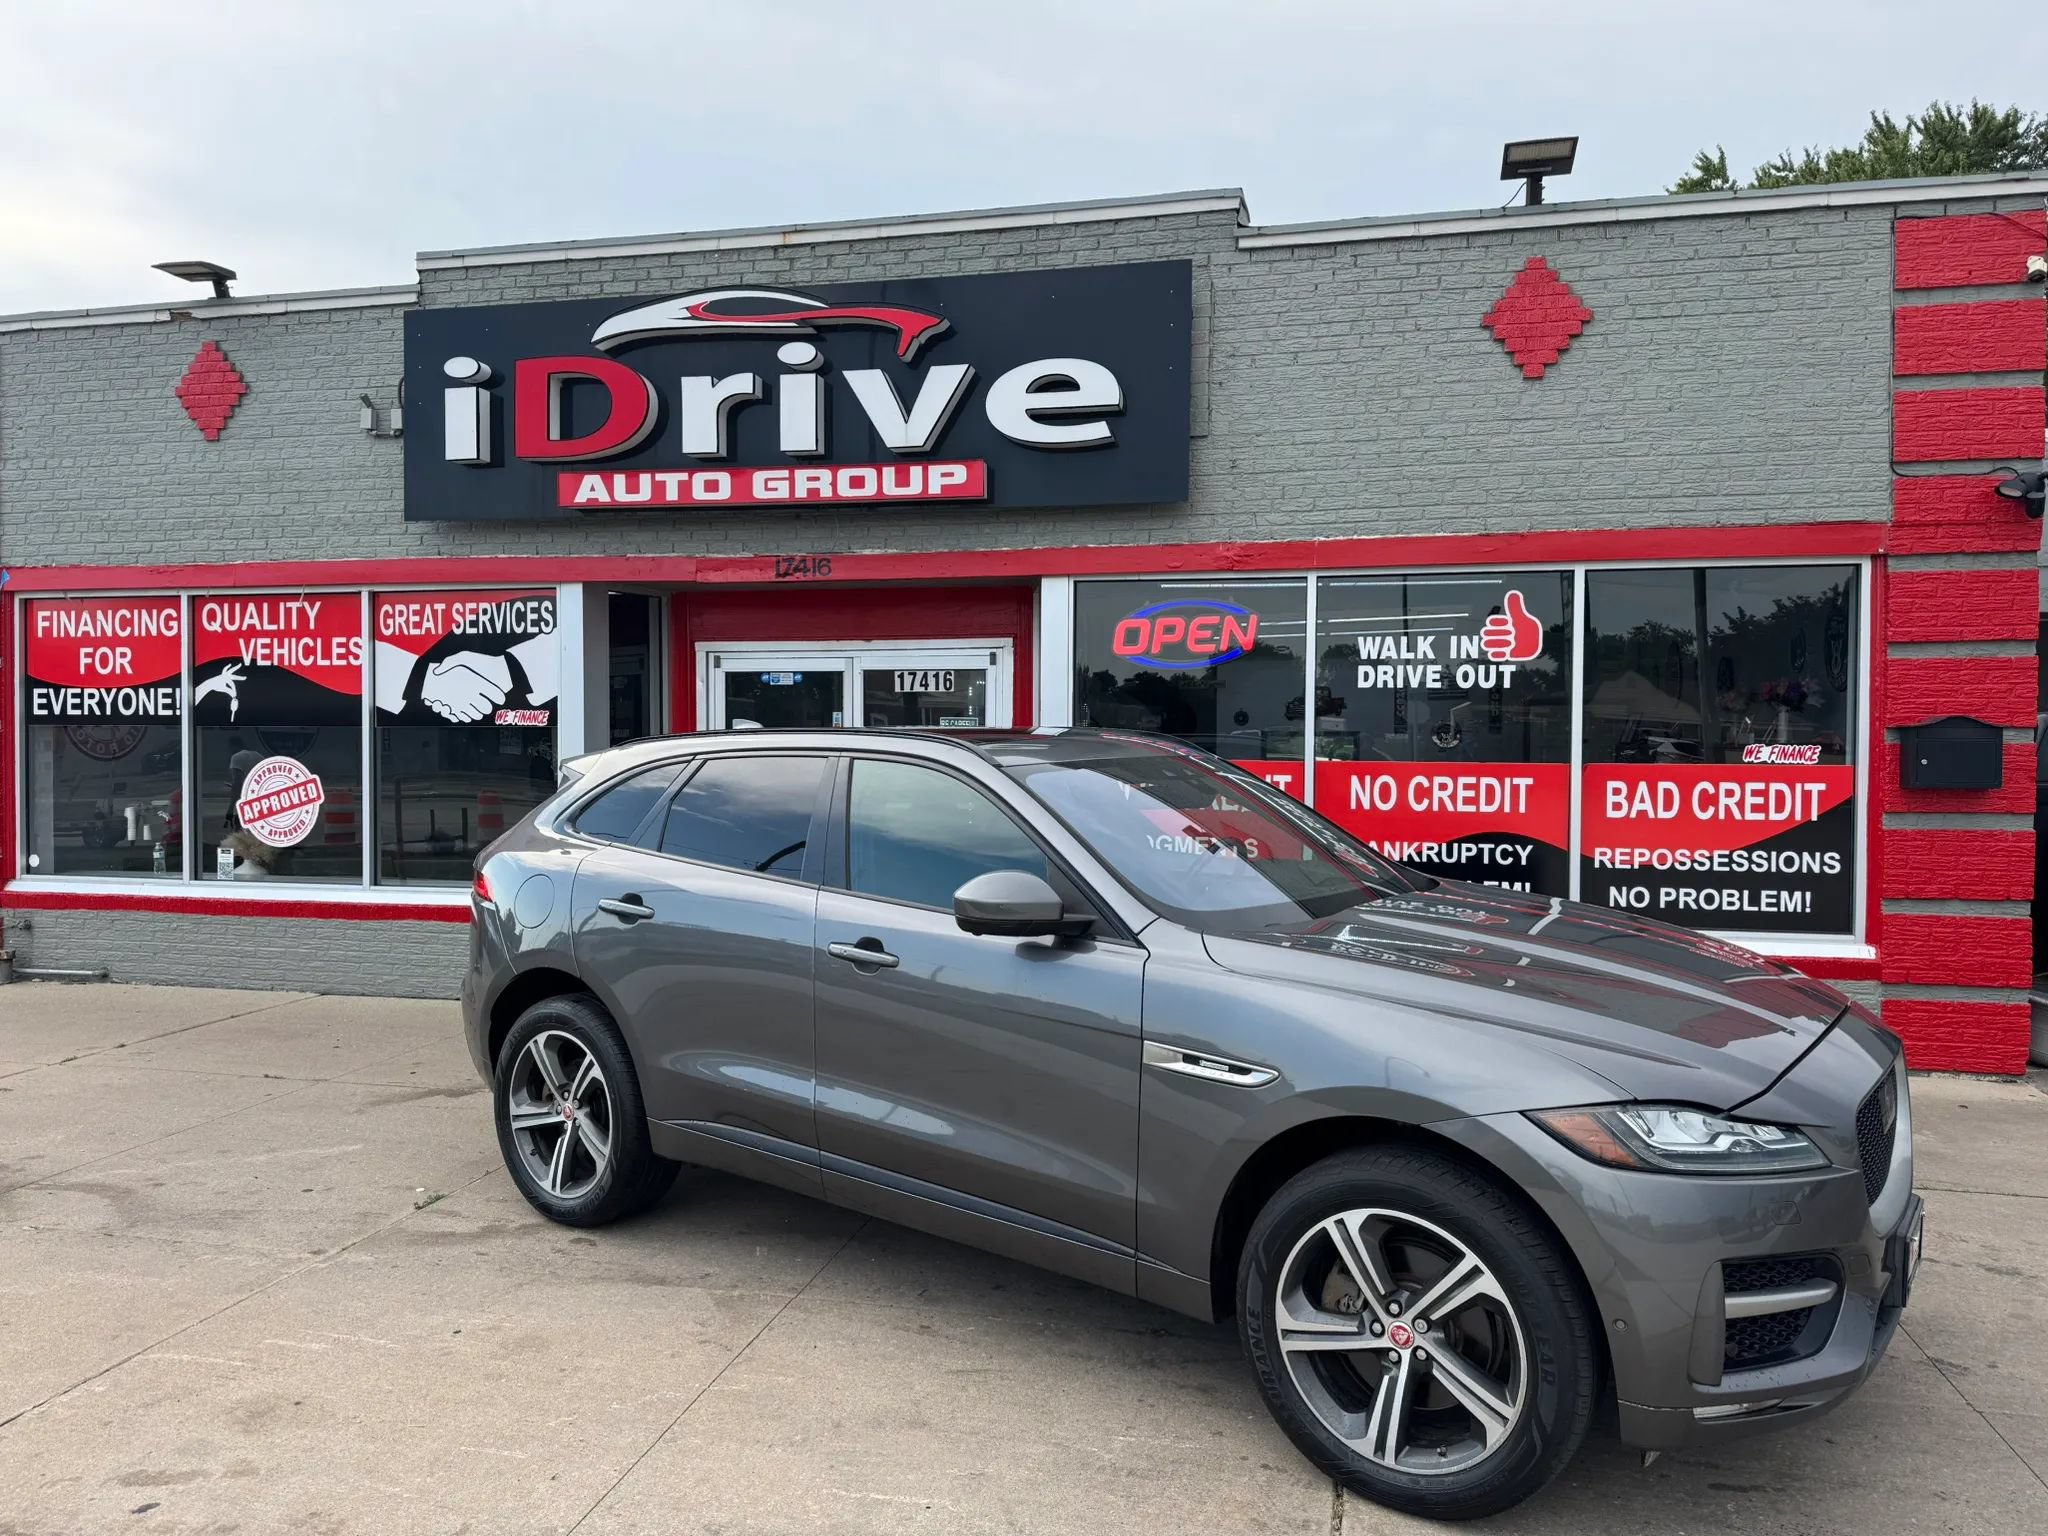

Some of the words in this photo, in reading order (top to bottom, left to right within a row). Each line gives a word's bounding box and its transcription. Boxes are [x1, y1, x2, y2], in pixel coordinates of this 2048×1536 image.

[443, 341, 1124, 466] iDrive
[574, 472, 732, 503] AUTO
[753, 465, 967, 499] GROUP
[776, 558, 832, 578] 17416
[37, 608, 178, 638] FINANCING
[202, 601, 321, 633] QUALITY
[380, 603, 446, 636] GREAT
[451, 600, 555, 635] SERVICES
[1113, 614, 1258, 656] OPEN
[1357, 635, 1436, 660] WALK
[1450, 635, 1479, 659] IN
[79, 646, 133, 675] FOR
[239, 636, 362, 667] VEHICLES
[896, 671, 953, 691] 17416
[1357, 664, 1442, 689] DRIVE
[1455, 664, 1517, 689] OUT
[33, 687, 181, 716] EVERYONE!
[495, 709, 511, 724] WE
[511, 709, 549, 725] FINANCE
[1743, 744, 1765, 762] WE
[1767, 745, 1821, 764] FINANCE
[254, 764, 293, 786] APPROVED
[243, 782, 318, 821] APPROVED
[1350, 774, 1397, 811] NO
[1407, 775, 1534, 814] CREDIT
[1606, 780, 1680, 819] BAD
[1692, 781, 1826, 822] CREDIT
[267, 818, 306, 838] APPROVED
[1368, 840, 1534, 866] ANKRUPTCY
[1594, 847, 1841, 874] REPOSSESSIONS
[1609, 886, 1650, 908] NO
[1659, 887, 1811, 913] PROBLEM!
